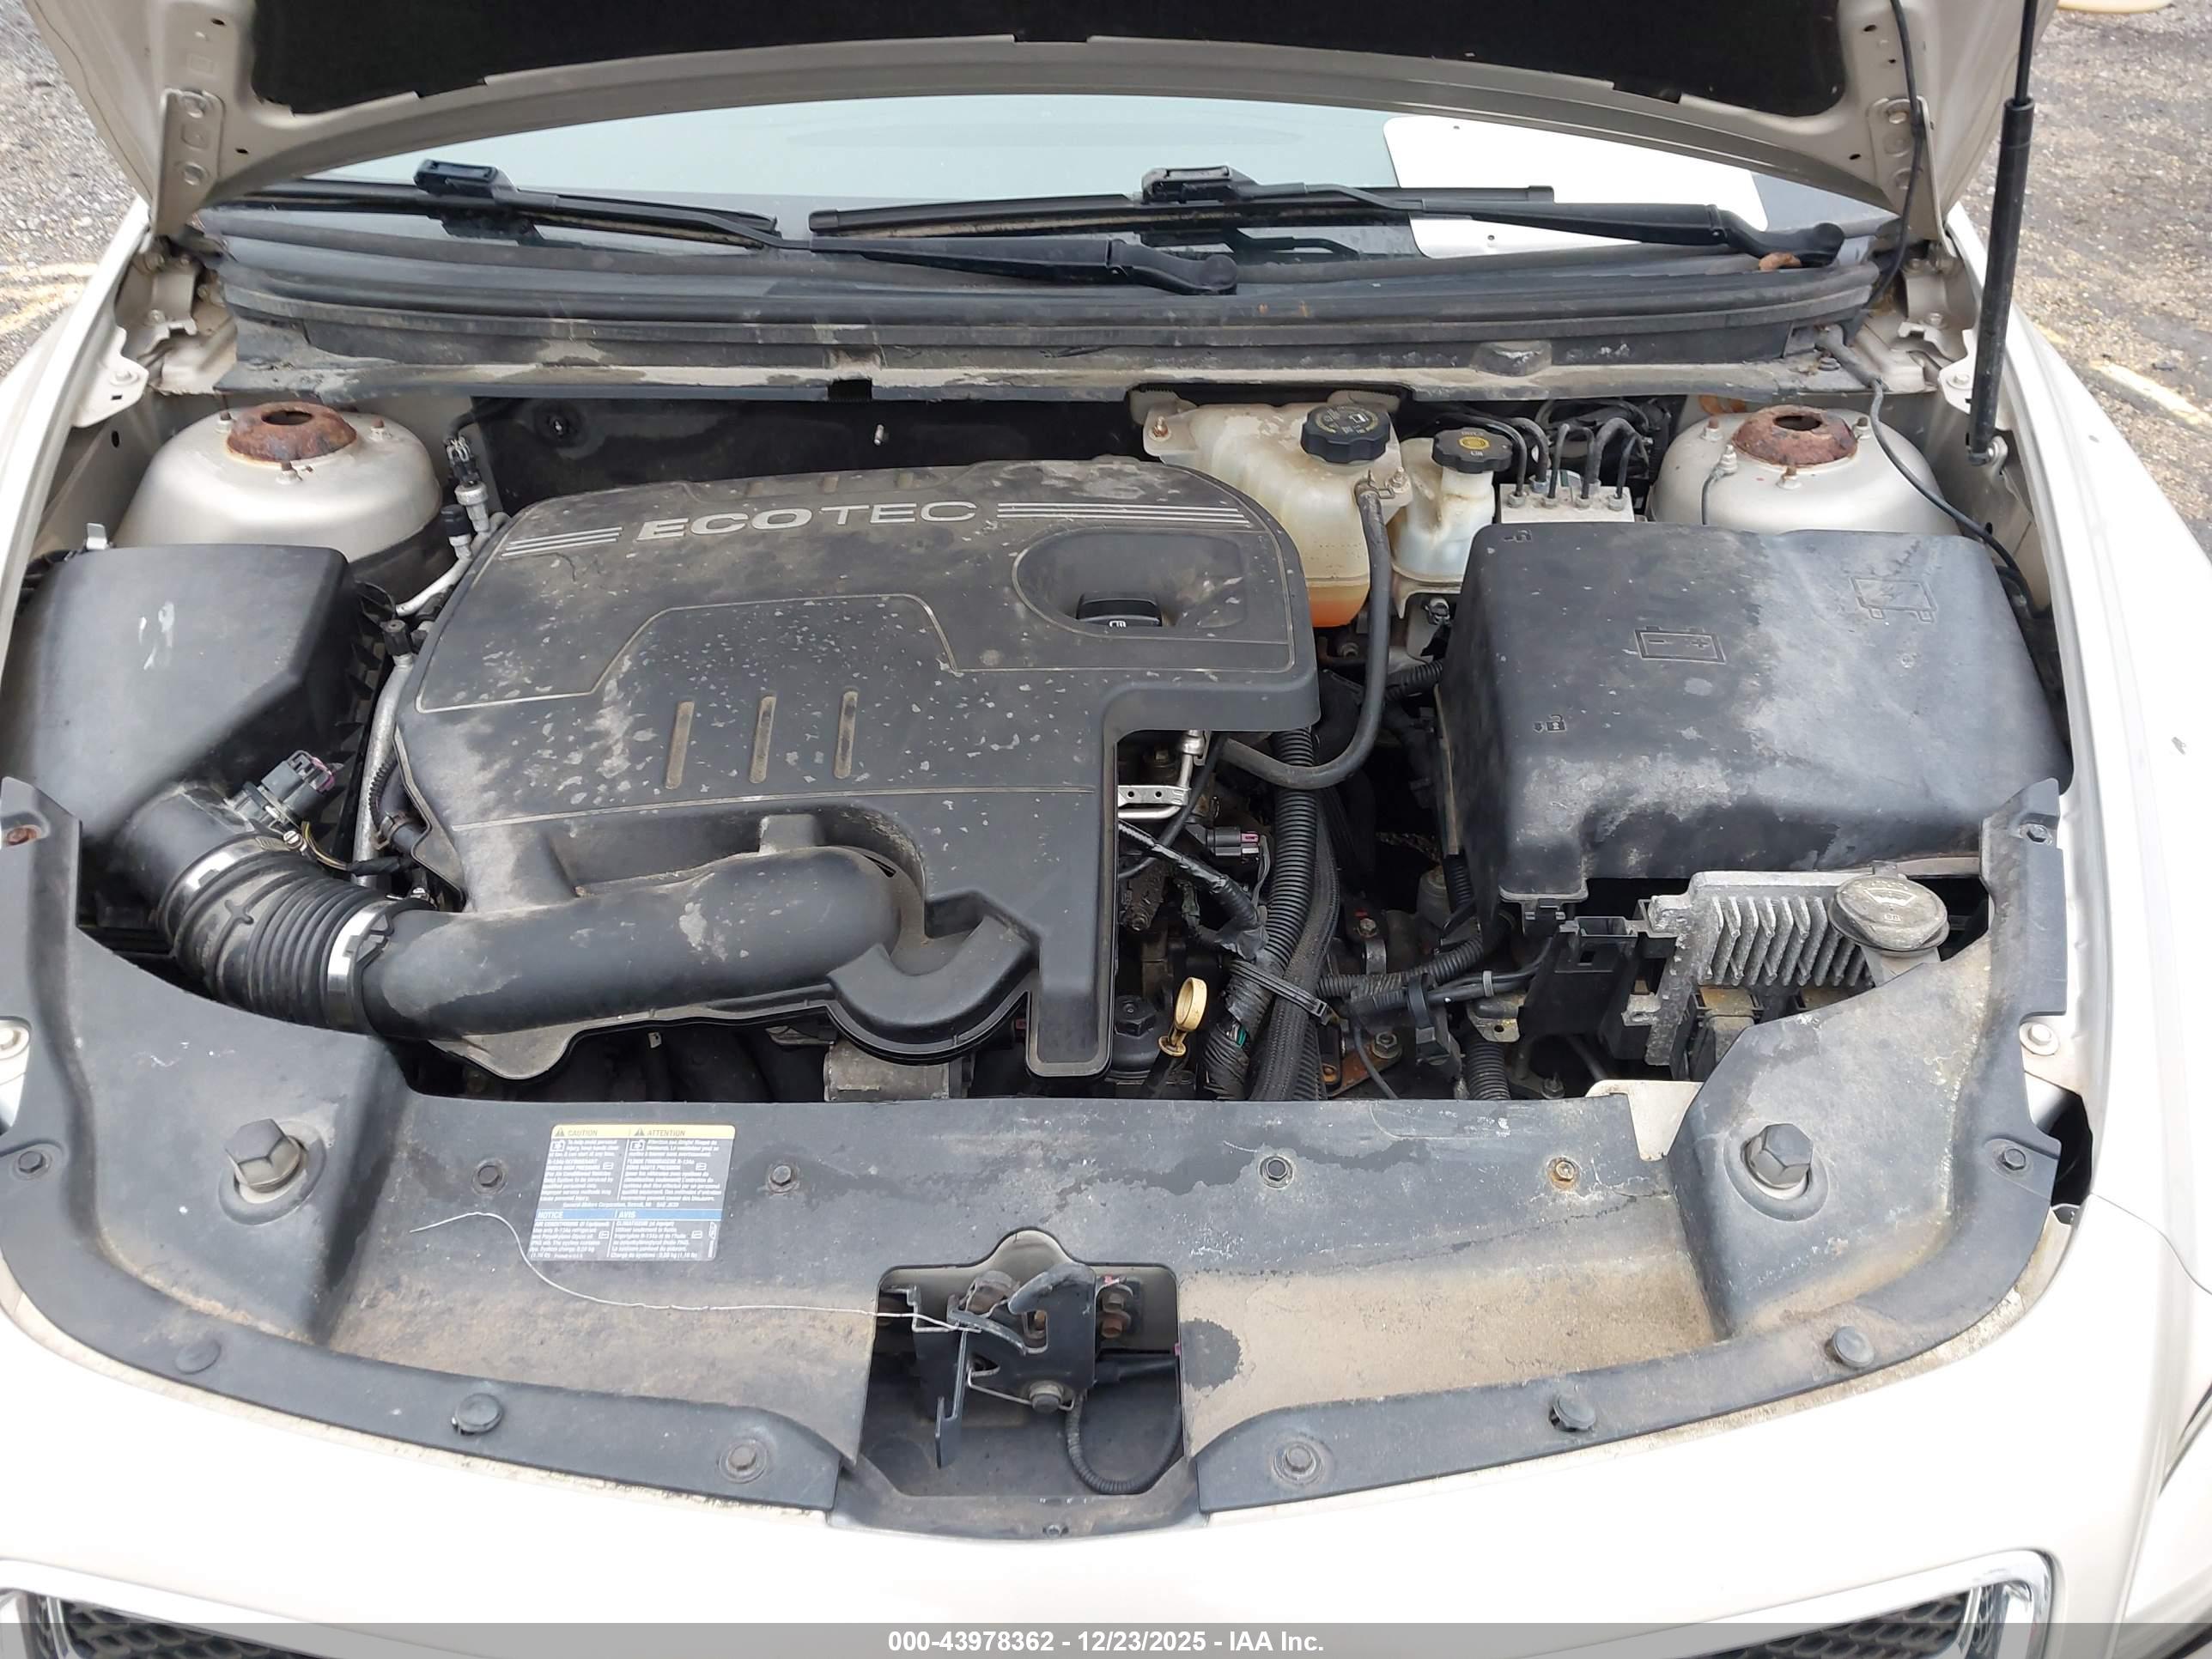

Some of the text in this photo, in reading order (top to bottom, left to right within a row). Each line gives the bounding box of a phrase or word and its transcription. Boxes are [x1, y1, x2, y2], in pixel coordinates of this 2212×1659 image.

[635, 501, 977, 542] ECOTEC
[537, 1211, 564, 1219] NOTICE
[618, 1211, 637, 1219] AVIS
